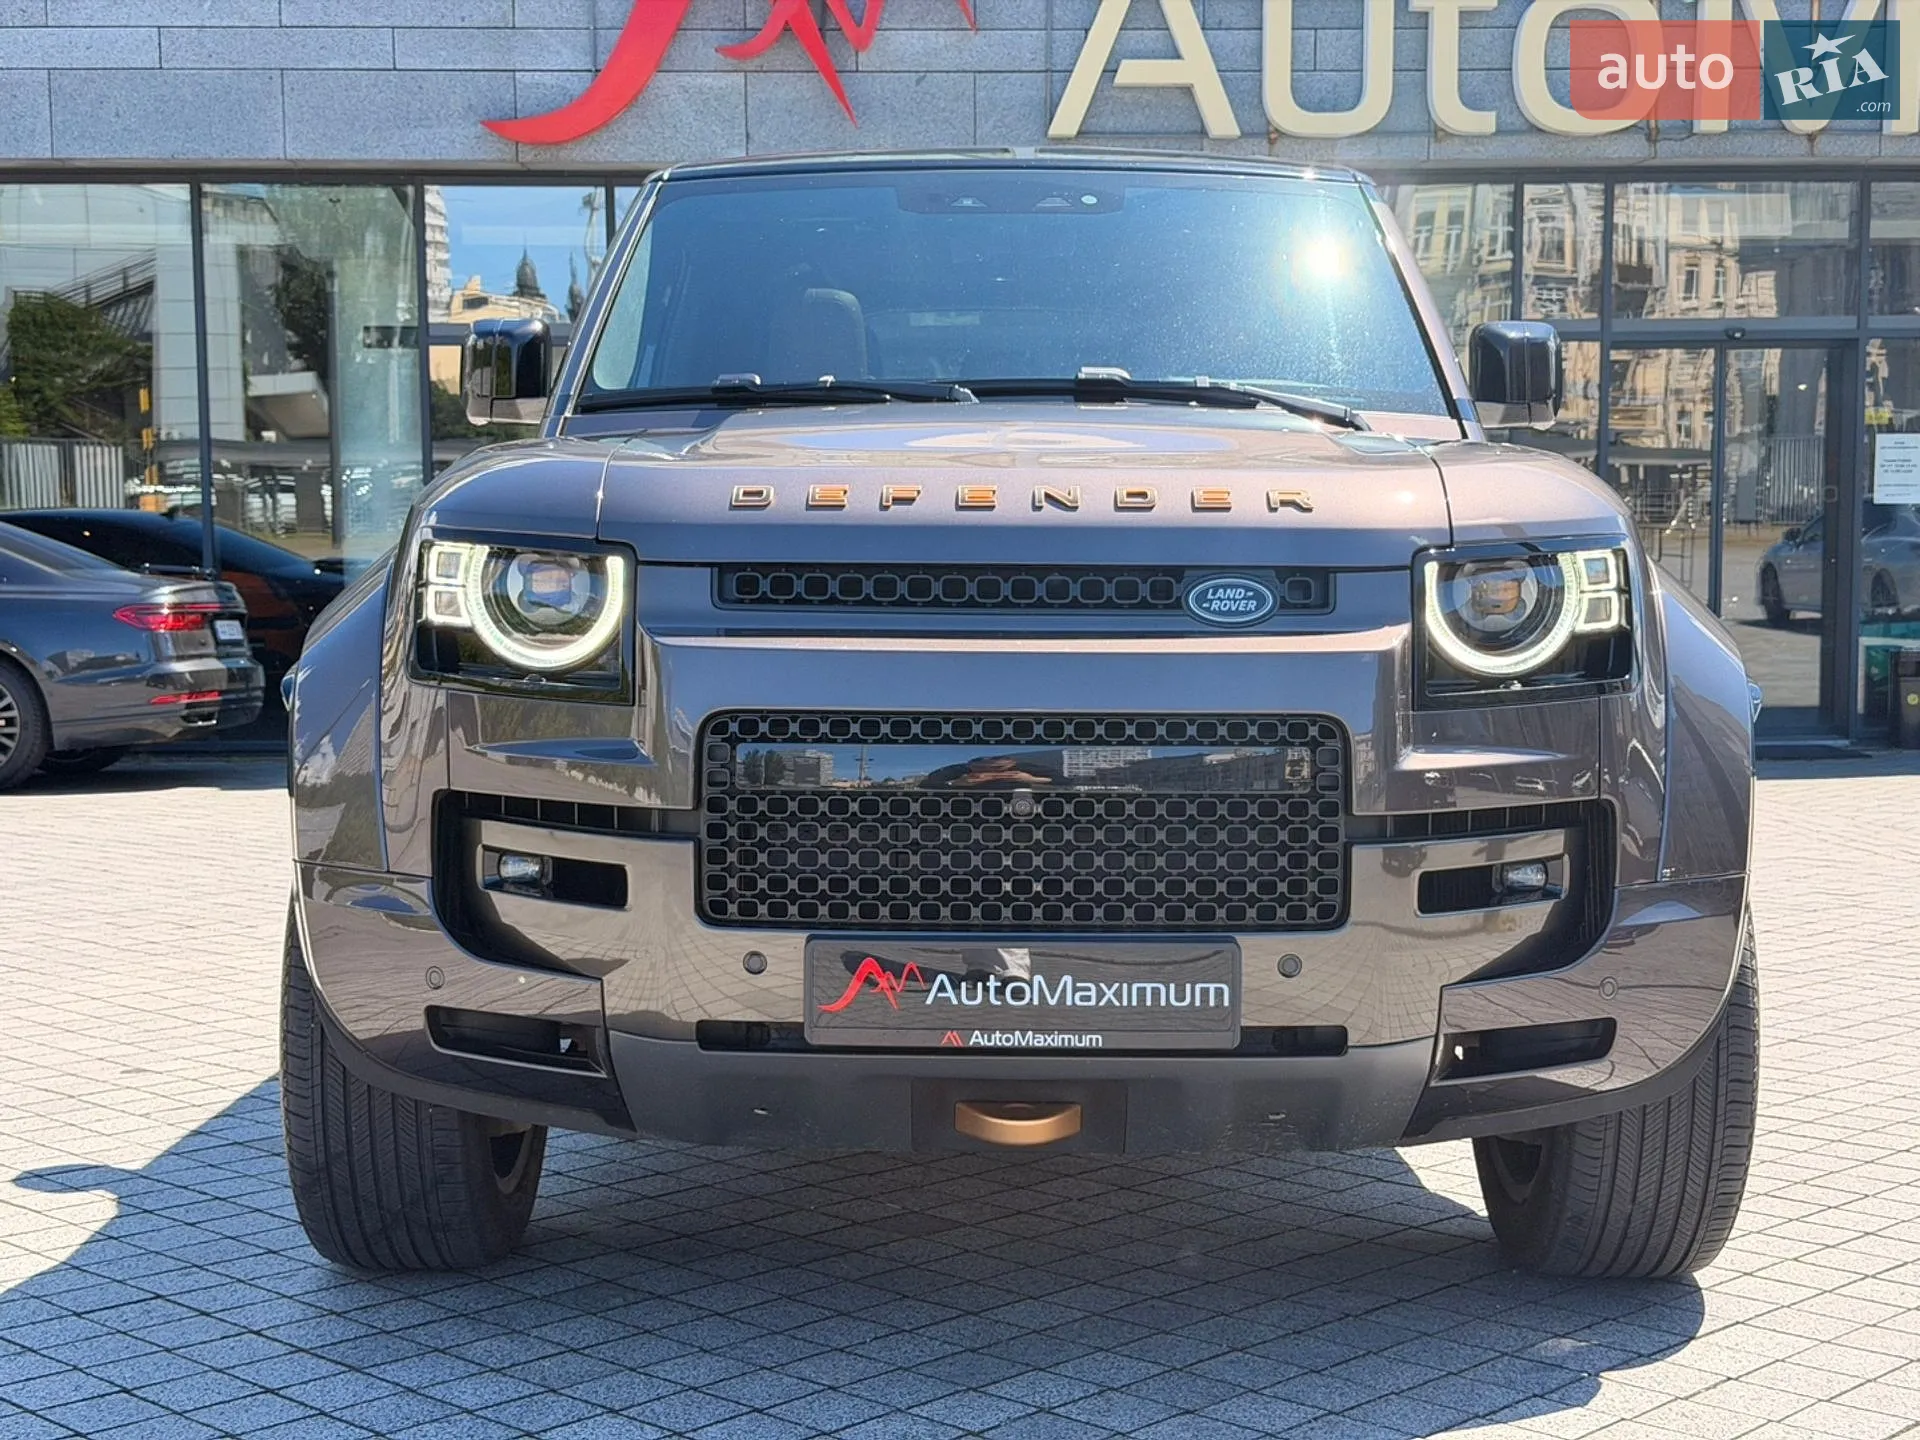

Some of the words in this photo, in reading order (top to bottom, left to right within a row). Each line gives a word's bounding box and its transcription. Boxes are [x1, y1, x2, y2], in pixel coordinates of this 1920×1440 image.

[729, 484, 1315, 511] DEFENDER
[925, 973, 1230, 1008] AutoMaximum
[968, 1030, 1103, 1048] AutoMaximum
